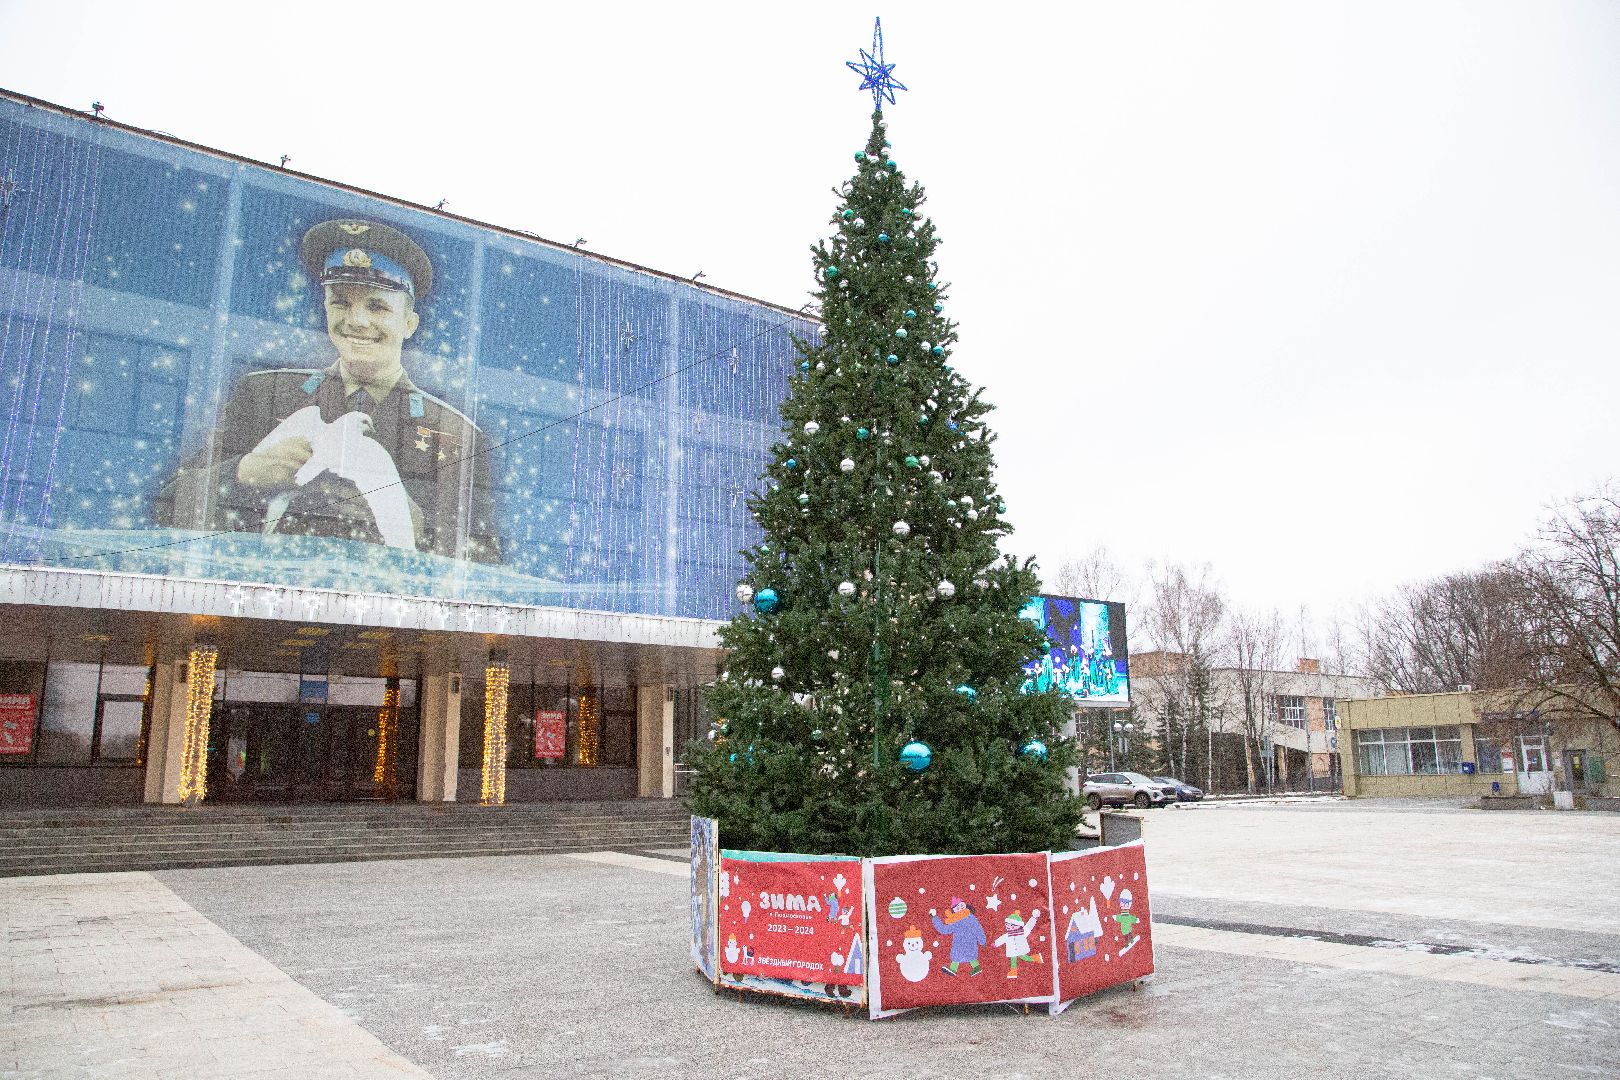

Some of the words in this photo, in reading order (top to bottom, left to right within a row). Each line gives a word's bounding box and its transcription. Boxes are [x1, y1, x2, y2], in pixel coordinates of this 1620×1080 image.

[760, 891, 821, 912] ЗИМА
[767, 924, 787, 933] 2023
[795, 926, 814, 935] 2024
[758, 955, 792, 967] ЗВЁЗДНЫЙ
[792, 959, 824, 970] ГОРОДОК
